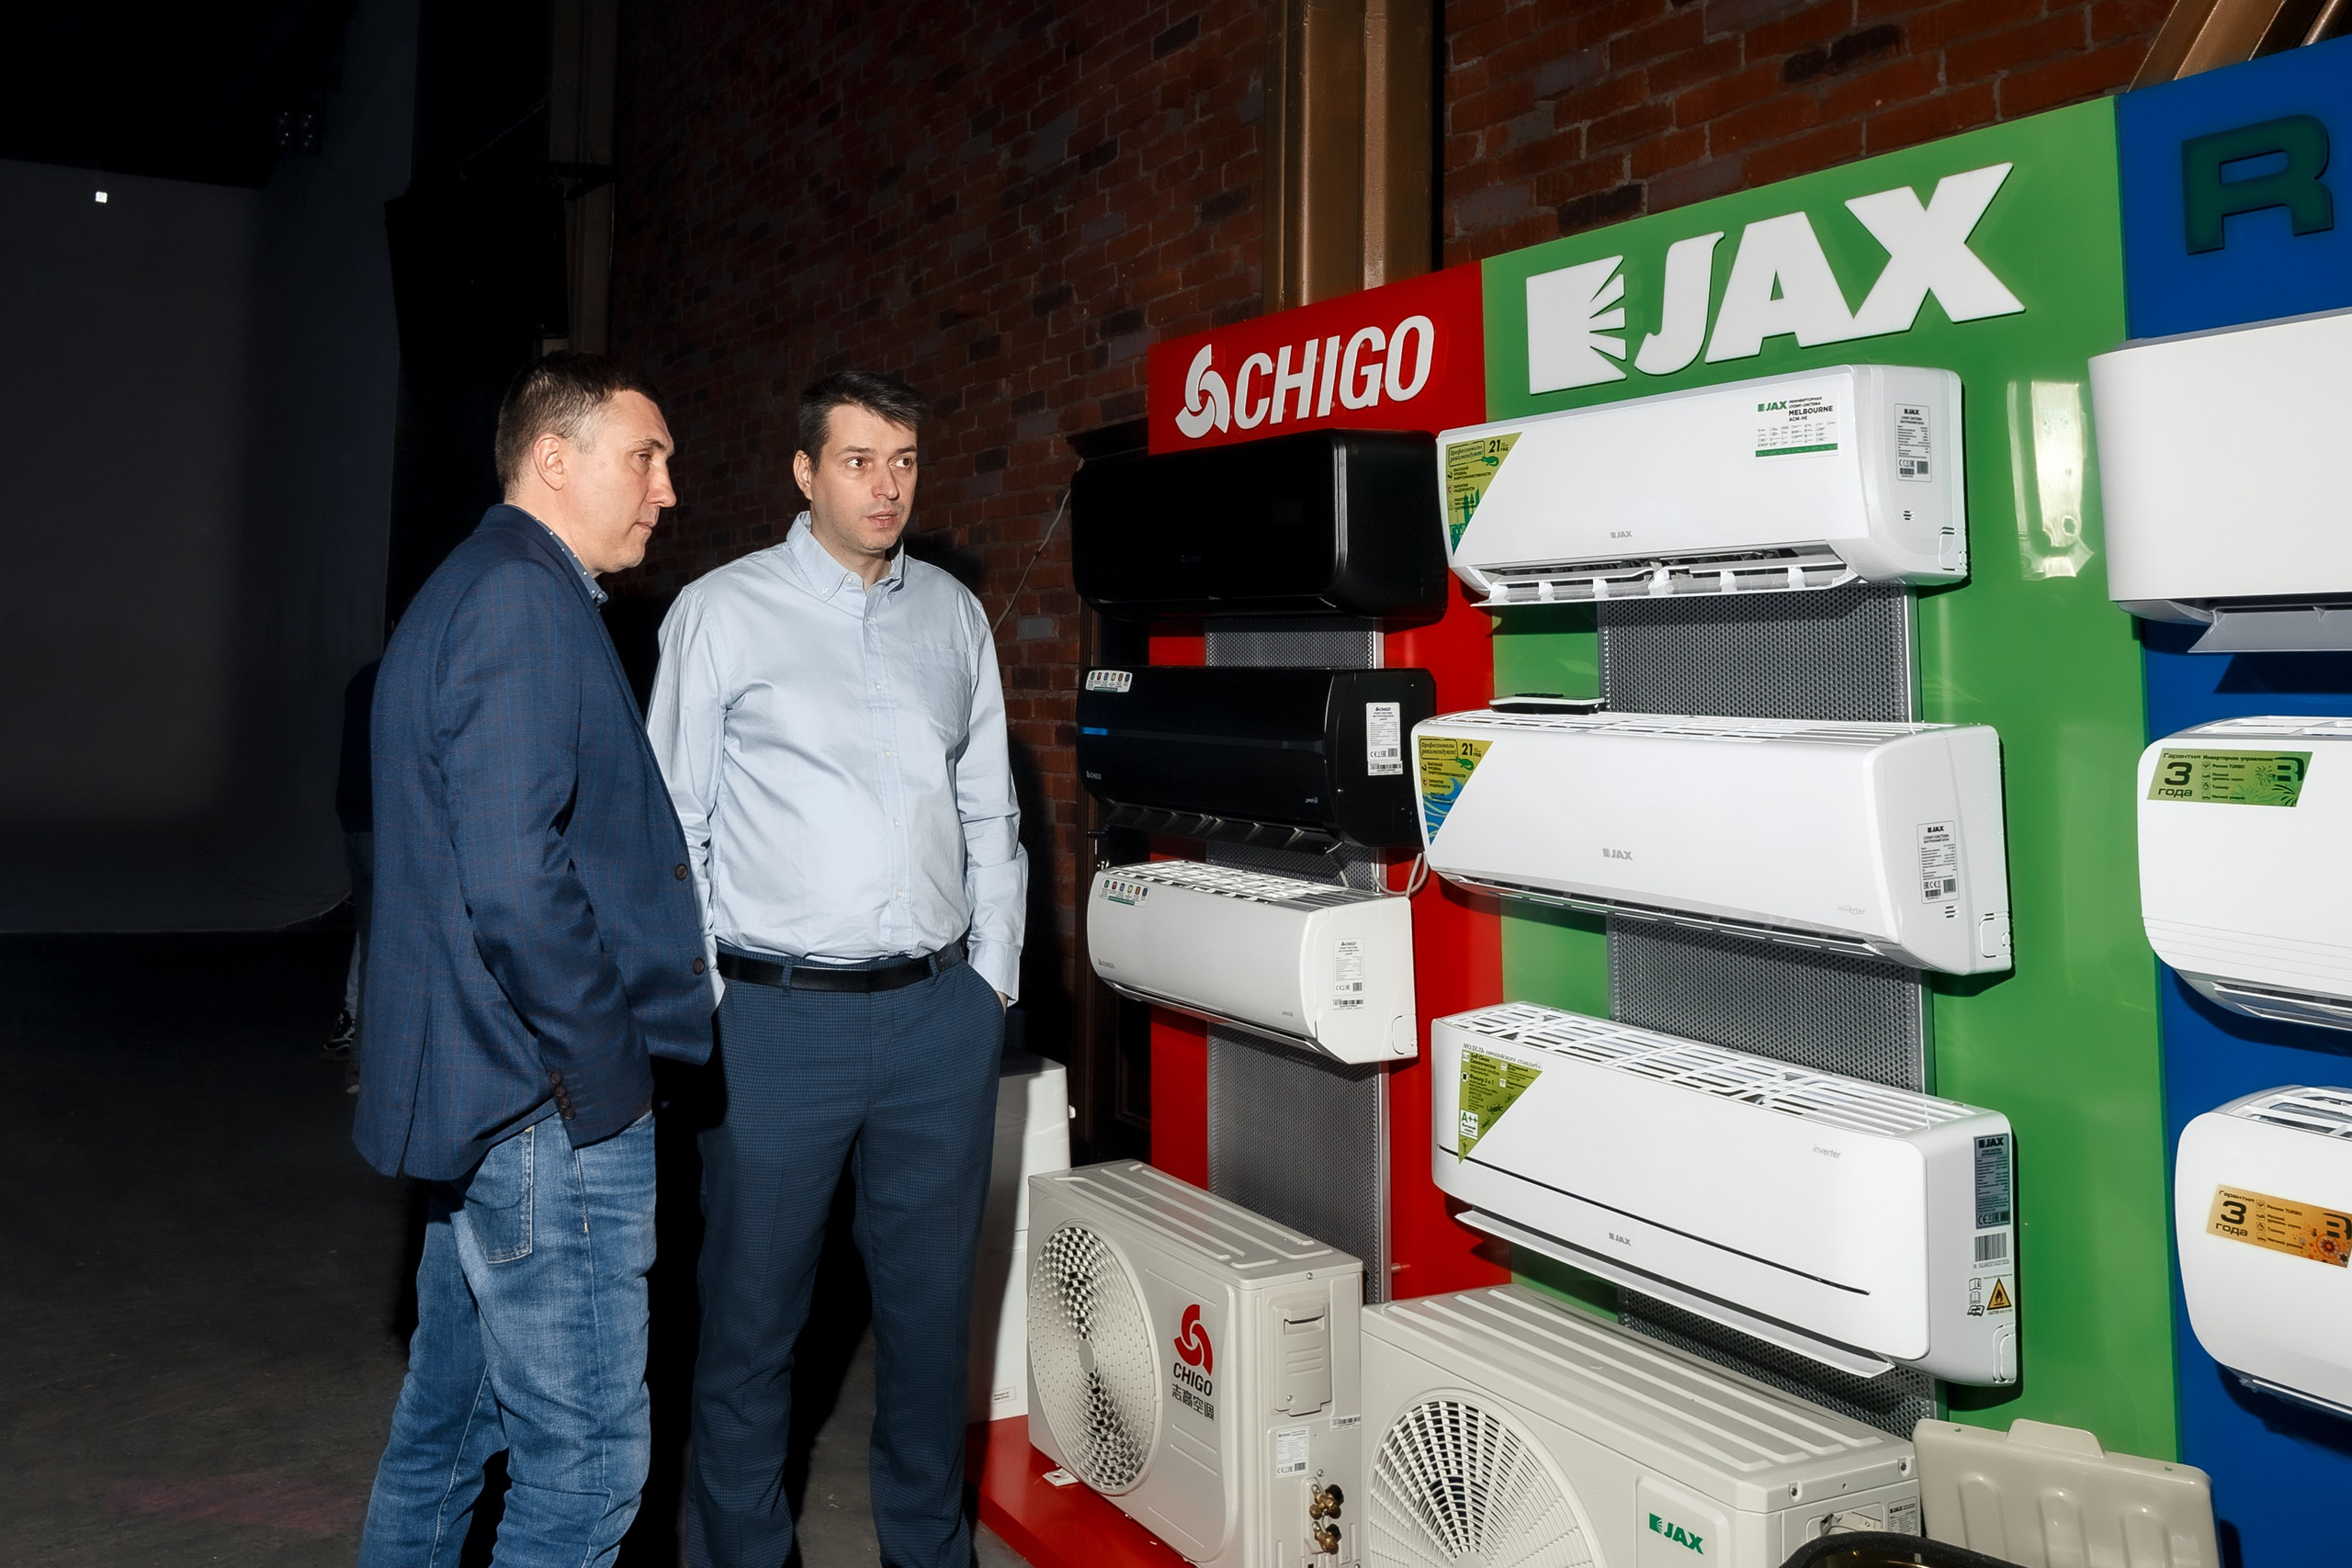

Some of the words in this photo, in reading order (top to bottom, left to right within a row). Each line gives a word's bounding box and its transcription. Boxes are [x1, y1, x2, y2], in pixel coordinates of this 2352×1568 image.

[1234, 314, 1435, 430] CHIGO
[1788, 405, 1834, 416] MELBOURNE
[1488, 439, 1500, 454] 21
[1462, 742, 1473, 756] 21
[2164, 761, 2193, 786] 3
[2158, 787, 2193, 798] года
[1463, 1043, 1485, 1054] МОДЕЛЬ
[1517, 1059, 1541, 1069] СТАНДАРТА
[1461, 1111, 1477, 1123] A++
[1813, 1144, 1841, 1158] inverter
[2219, 1190, 2255, 1203] Гарантия
[2221, 1200, 2246, 1224] 3
[2285, 1208, 2303, 1216] TURBO
[2215, 1223, 2248, 1236] года
[1173, 1362, 1213, 1397] CHIGO
